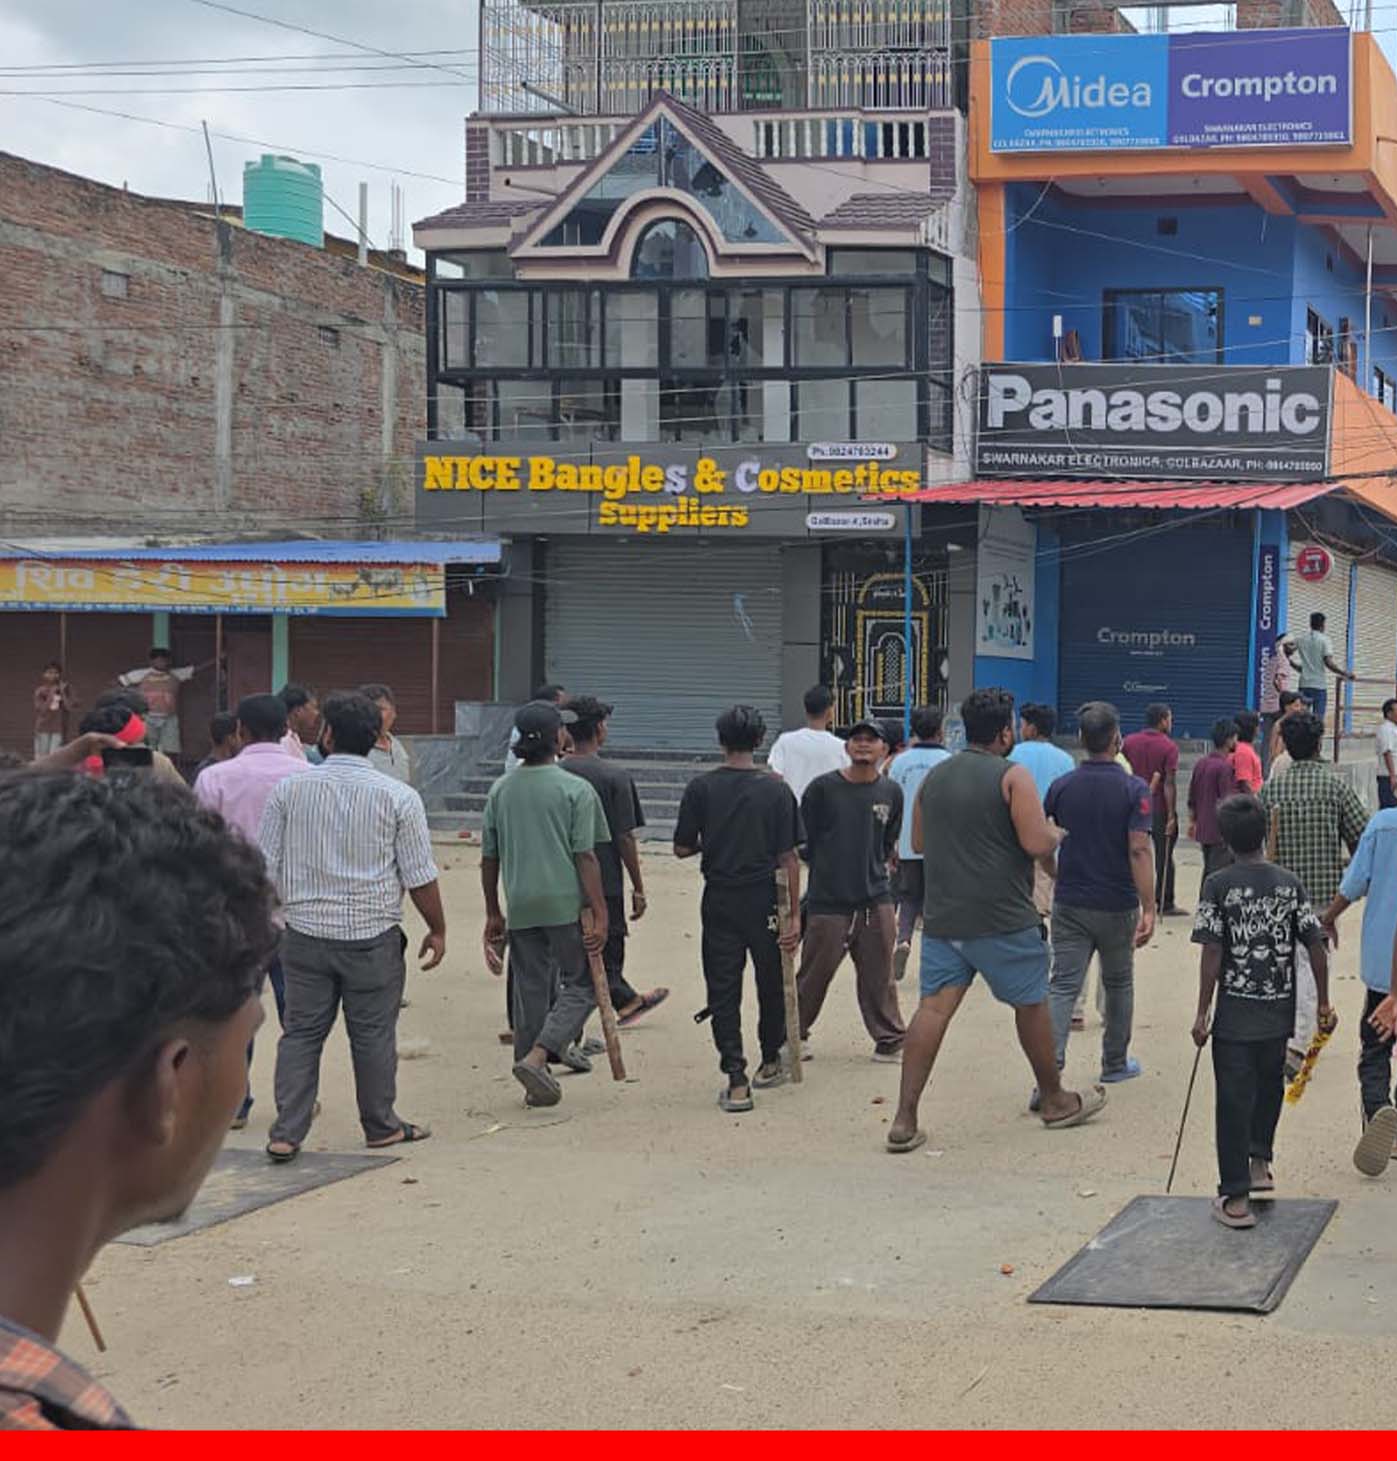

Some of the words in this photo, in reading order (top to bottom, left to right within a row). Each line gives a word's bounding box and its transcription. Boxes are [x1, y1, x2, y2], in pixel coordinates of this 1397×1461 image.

[1033, 74, 1152, 109] Midea
[1181, 71, 1337, 102] Crompton
[987, 374, 1321, 433] Panasonic
[983, 452, 1066, 465] SWARNAKAR
[423, 456, 521, 491] NICE
[528, 455, 687, 500] Bangles
[694, 458, 725, 494] &
[735, 461, 921, 495] Cosmetics
[599, 496, 749, 532] Suppliers
[16, 560, 94, 592] शिव
[1260, 554, 1275, 630] Crompton
[1097, 627, 1196, 649] Crompton
